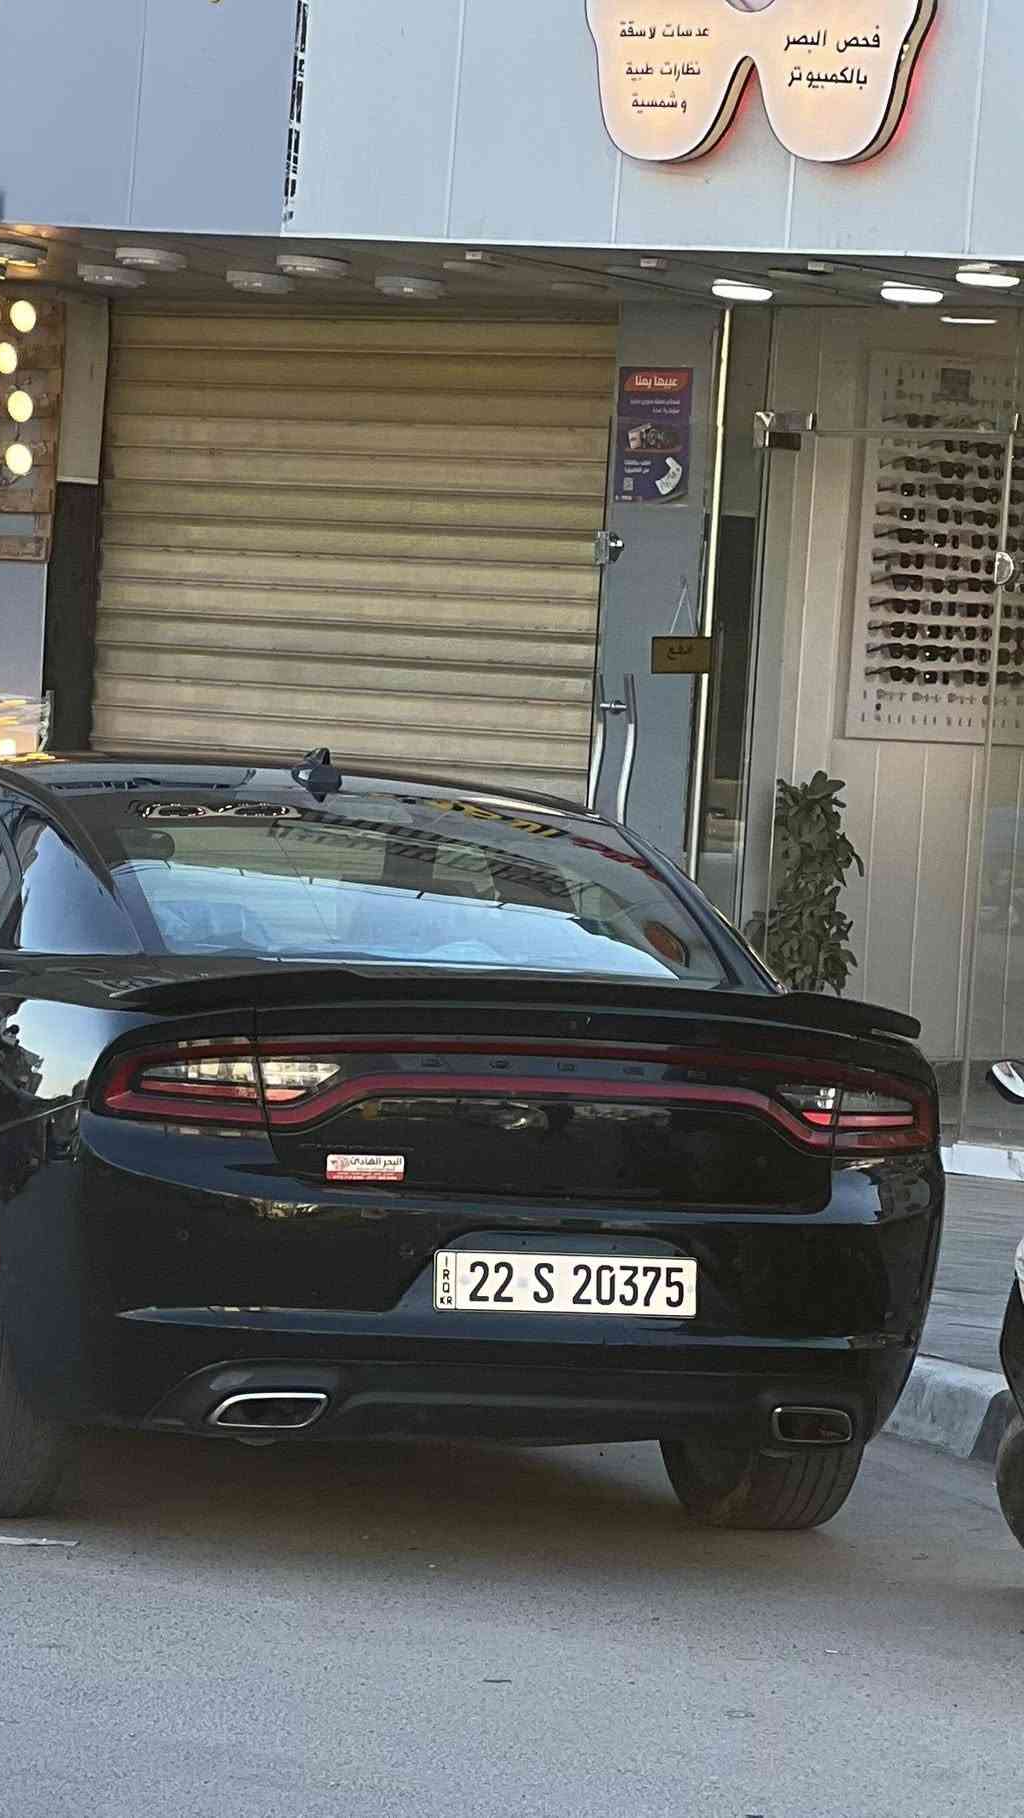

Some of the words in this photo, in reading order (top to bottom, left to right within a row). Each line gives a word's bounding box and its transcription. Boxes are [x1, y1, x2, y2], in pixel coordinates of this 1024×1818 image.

[663, 22, 709, 37] عدسات
[784, 29, 827, 54] البصر
[836, 24, 880, 53] فحص
[626, 61, 654, 81] طبية
[660, 61, 701, 82] نظارات
[788, 65, 867, 90] بالكمبيوتر
[632, 90, 687, 113] وشمسية
[469, 1261, 514, 1303] 22
[533, 1262, 555, 1304] S
[572, 1264, 684, 1308] 20375
